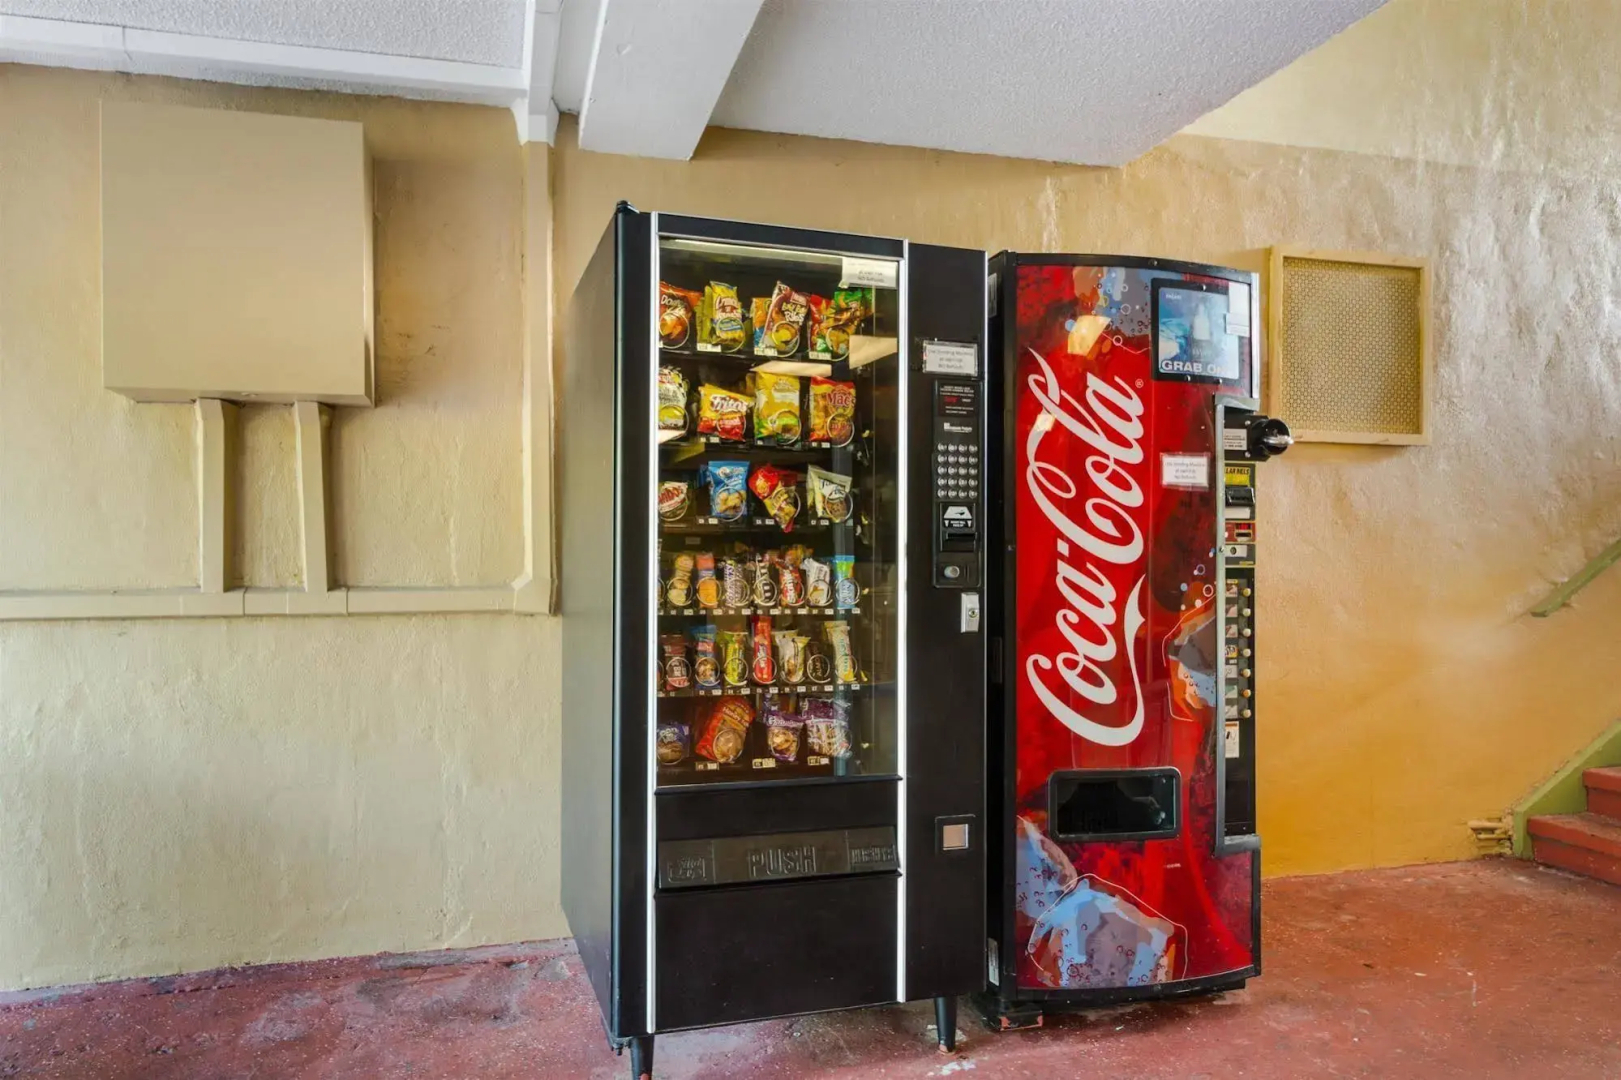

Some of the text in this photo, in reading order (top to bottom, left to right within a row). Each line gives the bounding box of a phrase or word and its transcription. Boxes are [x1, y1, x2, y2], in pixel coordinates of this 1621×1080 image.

[1161, 359, 1203, 373] GRAB
[710, 393, 749, 413] Fritos
[1026, 347, 1145, 747] Coca-Cola
[750, 846, 816, 878] PUSH
